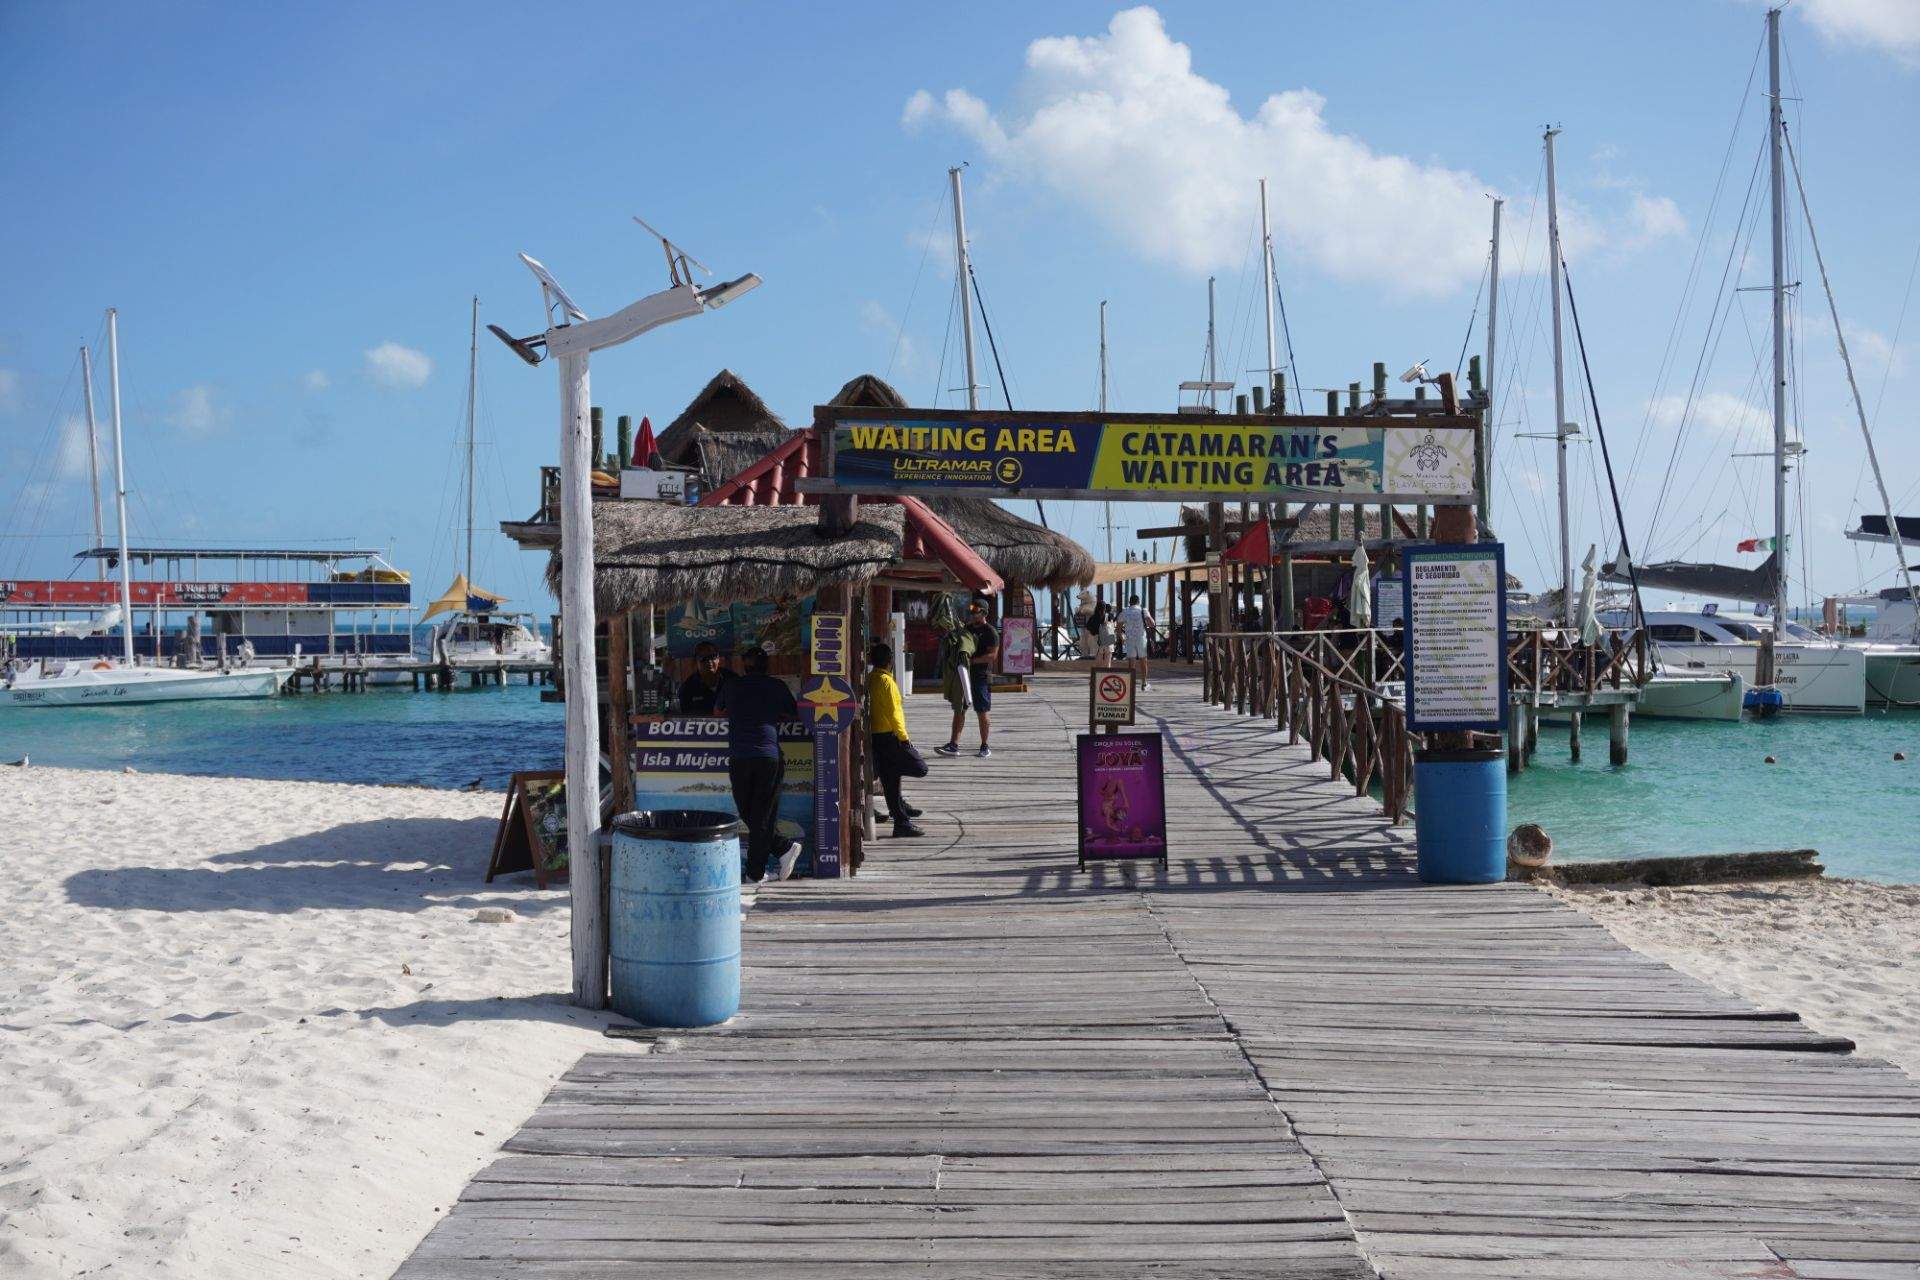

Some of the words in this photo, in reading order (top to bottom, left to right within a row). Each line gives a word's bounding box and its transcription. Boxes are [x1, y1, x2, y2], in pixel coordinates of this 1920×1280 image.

[850, 426, 986, 452] WAITING
[994, 428, 1077, 453] AREA
[1121, 432, 1338, 459] CATAMARAN'S
[893, 457, 992, 471] ULTRAMAR
[1121, 460, 1253, 485] WAITING
[1263, 461, 1345, 487] AREA
[1415, 565, 1457, 573] REGLAMENTO
[1425, 571, 1461, 579] SEGURIDAD
[648, 720, 730, 736] BOLETOS
[642, 752, 671, 767] Isla
[675, 752, 730, 770] Mujere
[819, 853, 838, 863] cm
